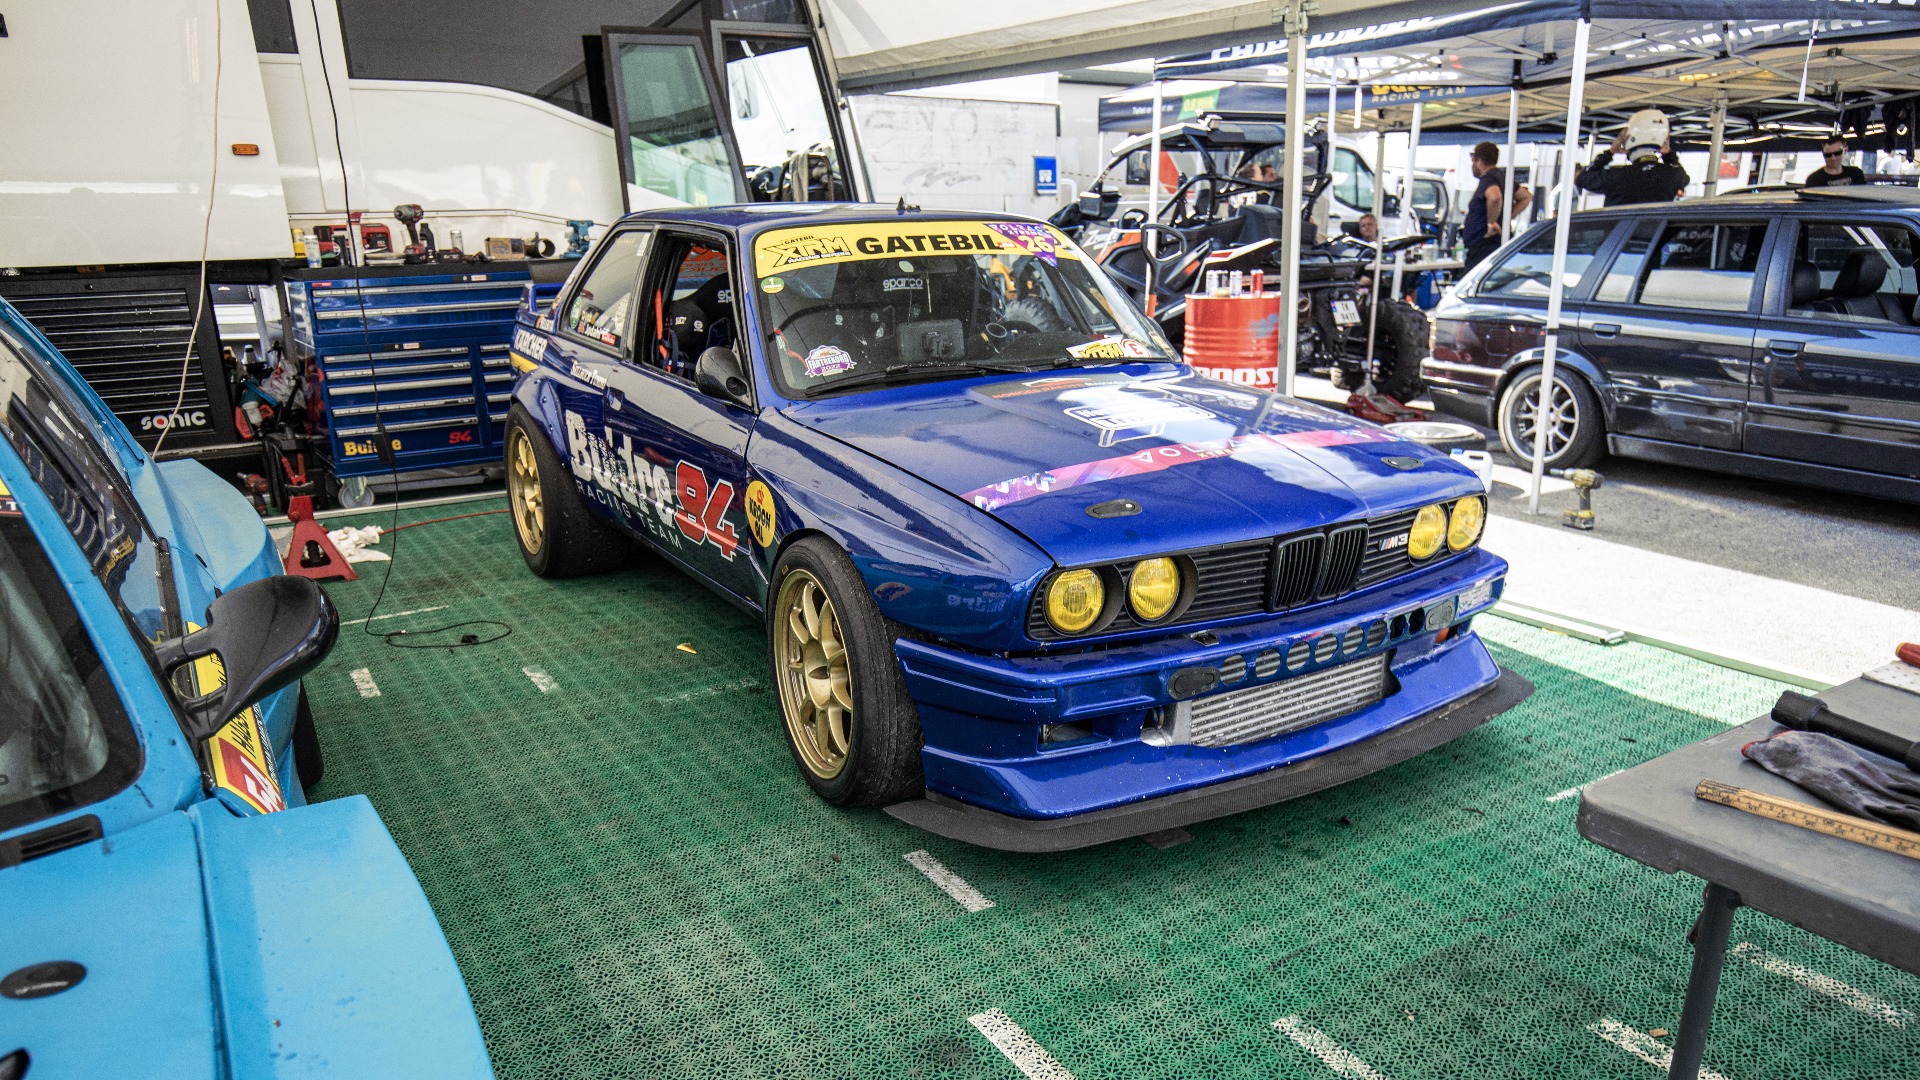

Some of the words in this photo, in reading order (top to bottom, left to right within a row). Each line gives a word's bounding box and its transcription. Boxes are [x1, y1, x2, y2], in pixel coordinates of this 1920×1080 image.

[784, 235, 815, 245] GATEBIL
[1018, 235, 1055, 253] 26
[883, 278, 923, 290] sparco
[575, 480, 632, 519] RACING
[638, 513, 682, 550] TEAM
[749, 497, 771, 531] KROON
[754, 520, 764, 543] OIL
